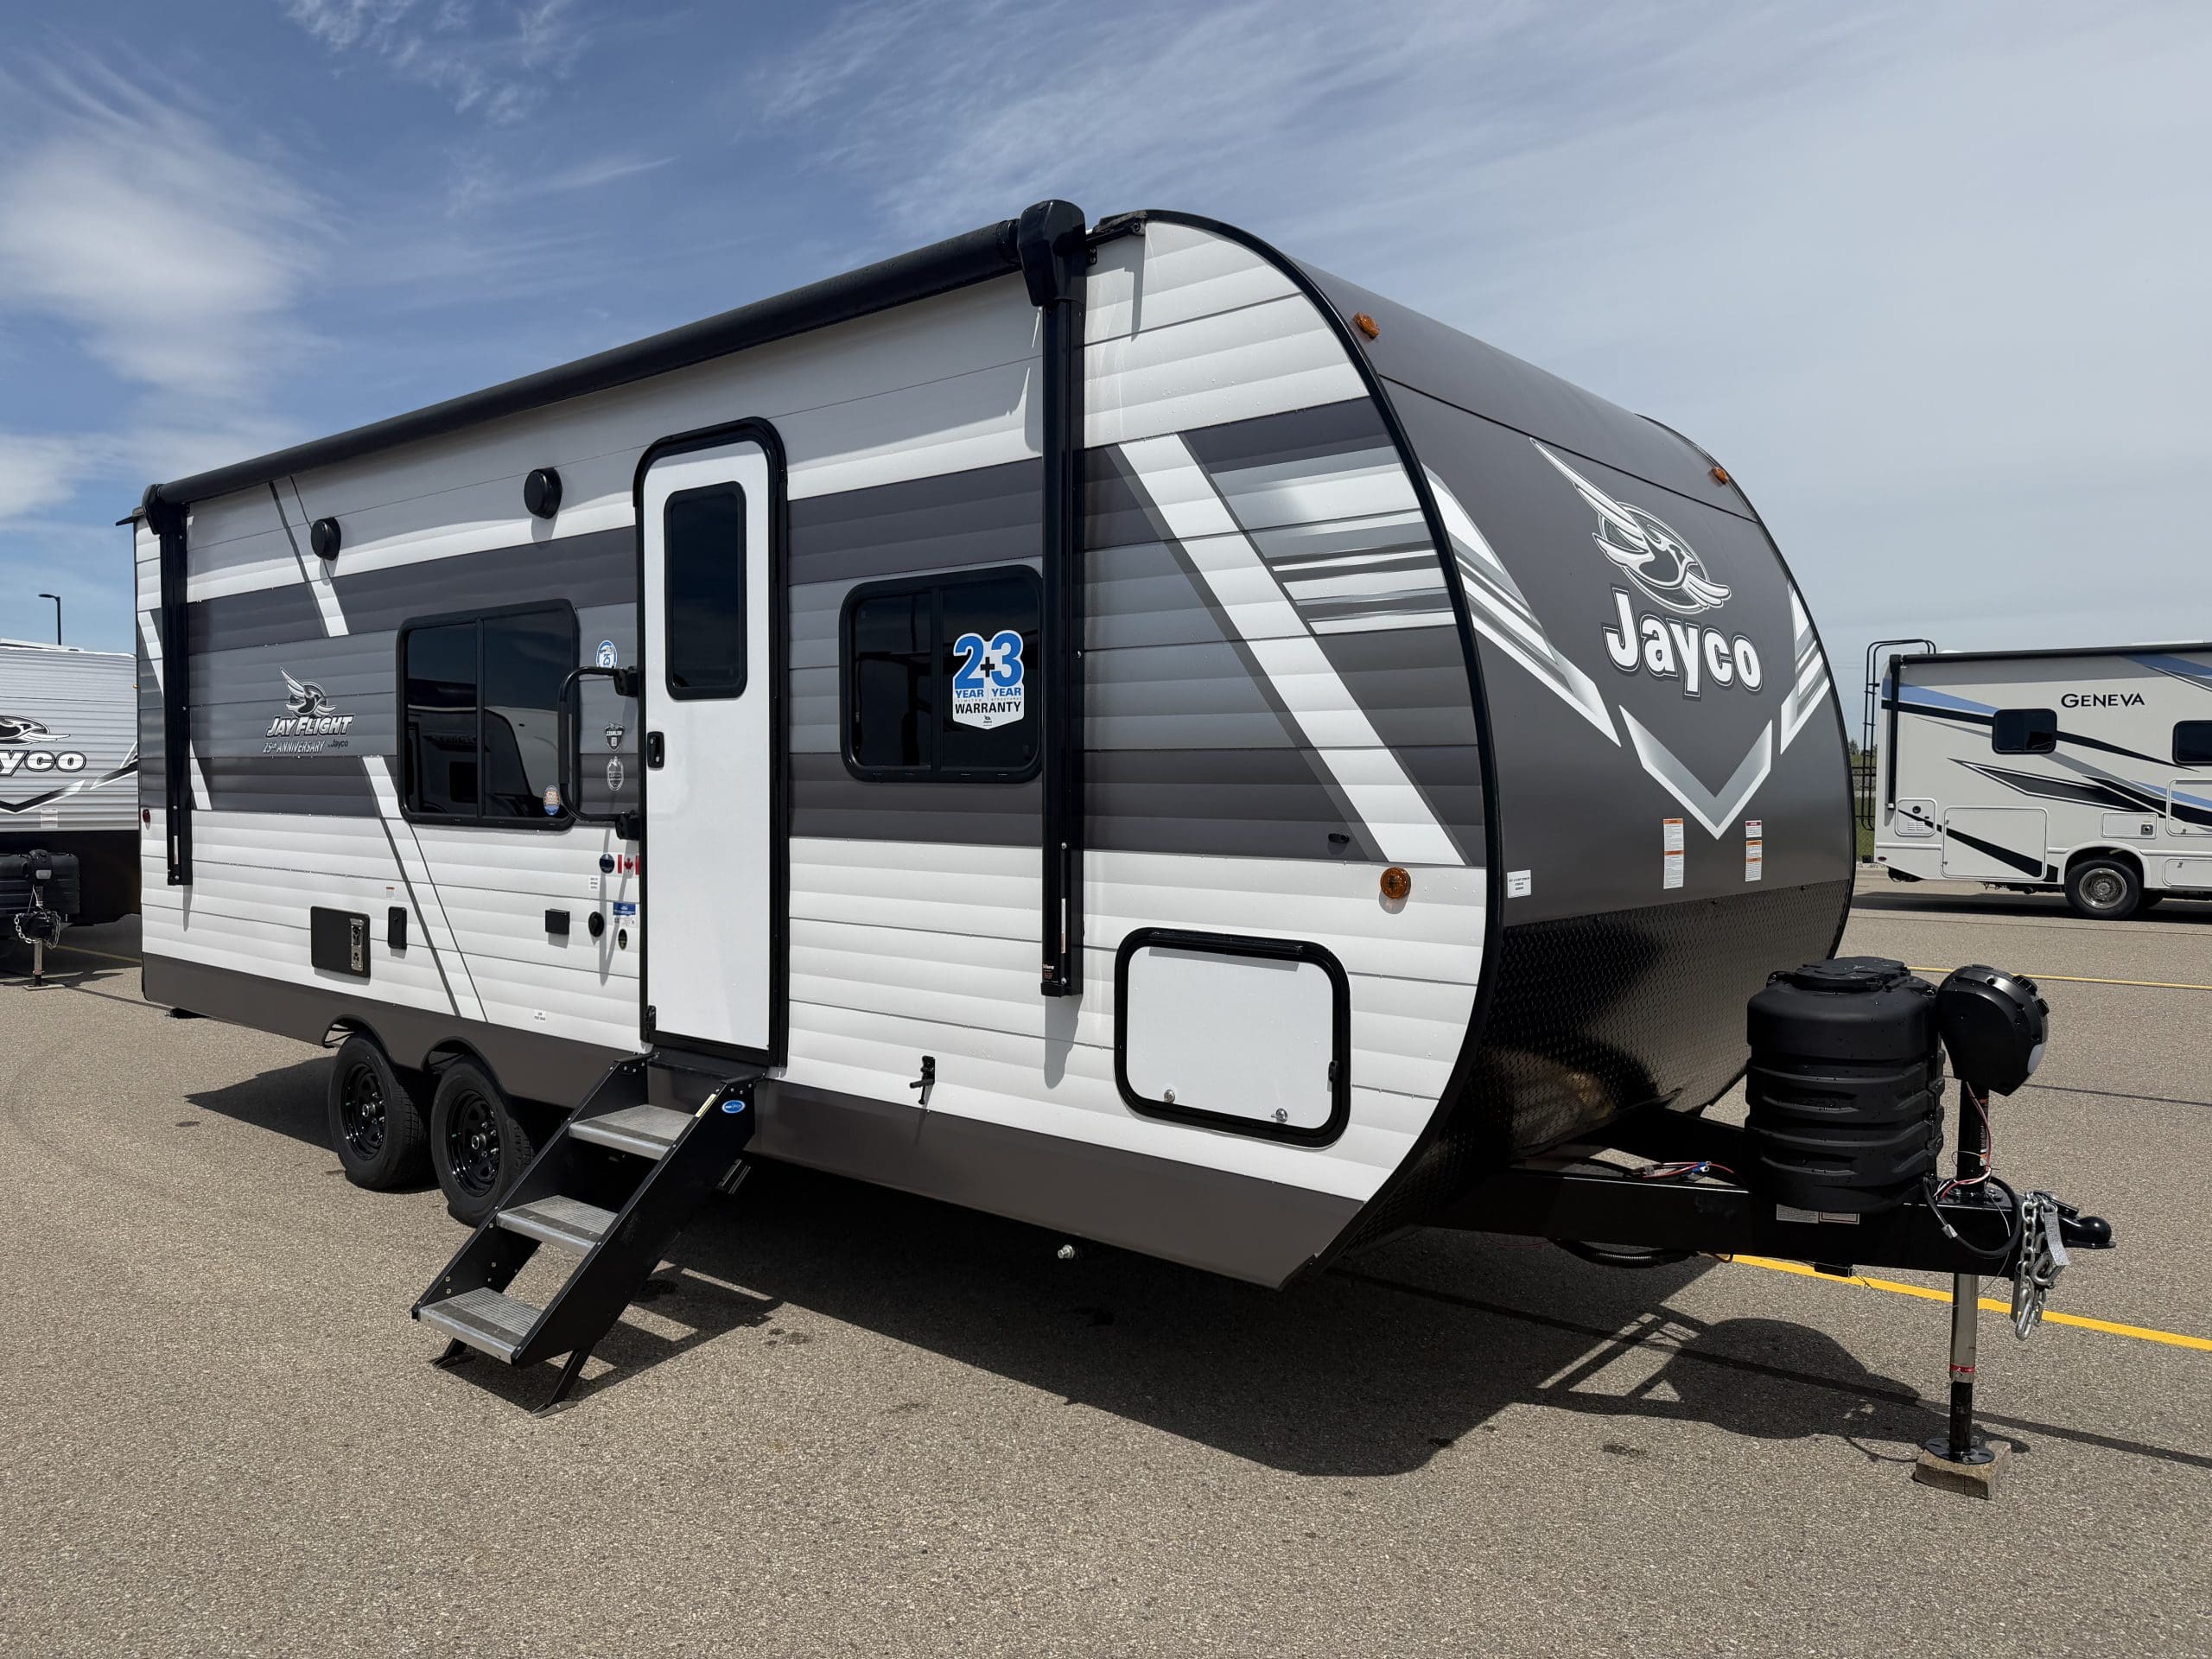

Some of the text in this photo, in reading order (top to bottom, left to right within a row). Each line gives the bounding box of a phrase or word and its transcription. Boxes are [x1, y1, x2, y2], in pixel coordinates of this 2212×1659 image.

[1602, 587, 1763, 698] Jayco
[956, 687, 1021, 698] YEAR YEAR
[955, 701, 1021, 714] WARRANTY
[2061, 693, 2145, 708] GENEVA
[266, 715, 355, 737] JAY FLIGHT
[276, 741, 325, 753] ANNIVERSARY
